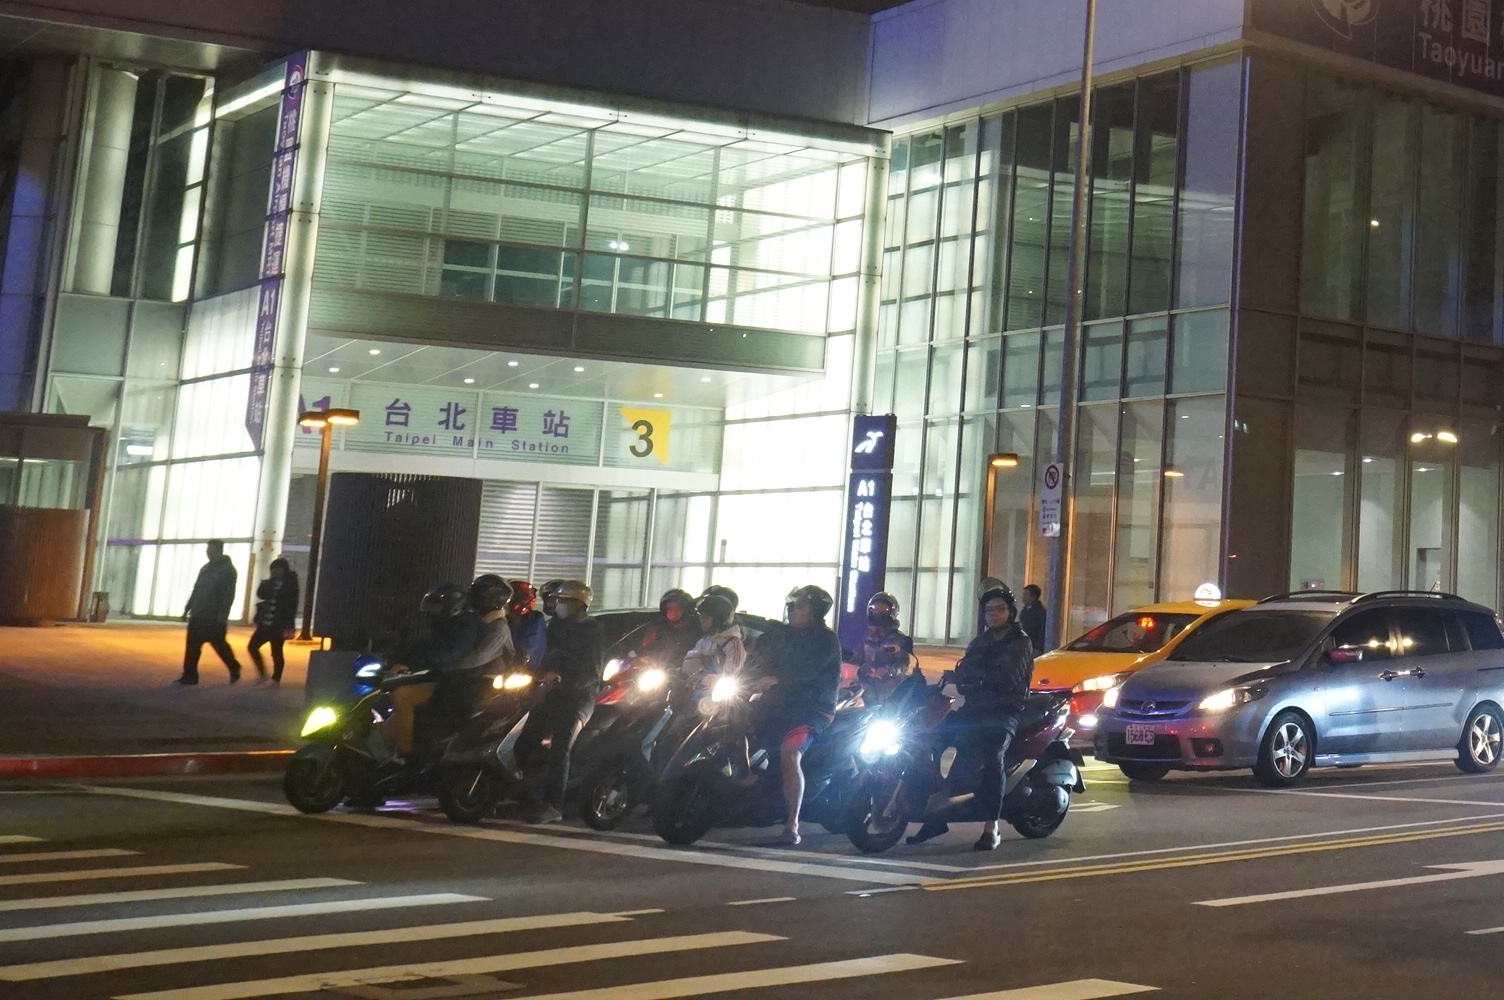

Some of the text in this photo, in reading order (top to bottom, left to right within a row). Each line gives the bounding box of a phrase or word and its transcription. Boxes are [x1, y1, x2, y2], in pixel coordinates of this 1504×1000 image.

[384, 397, 571, 439] 台北車站
[384, 431, 569, 454] Taipei Main Station
[629, 419, 654, 459] 3
[857, 480, 875, 497] A1
